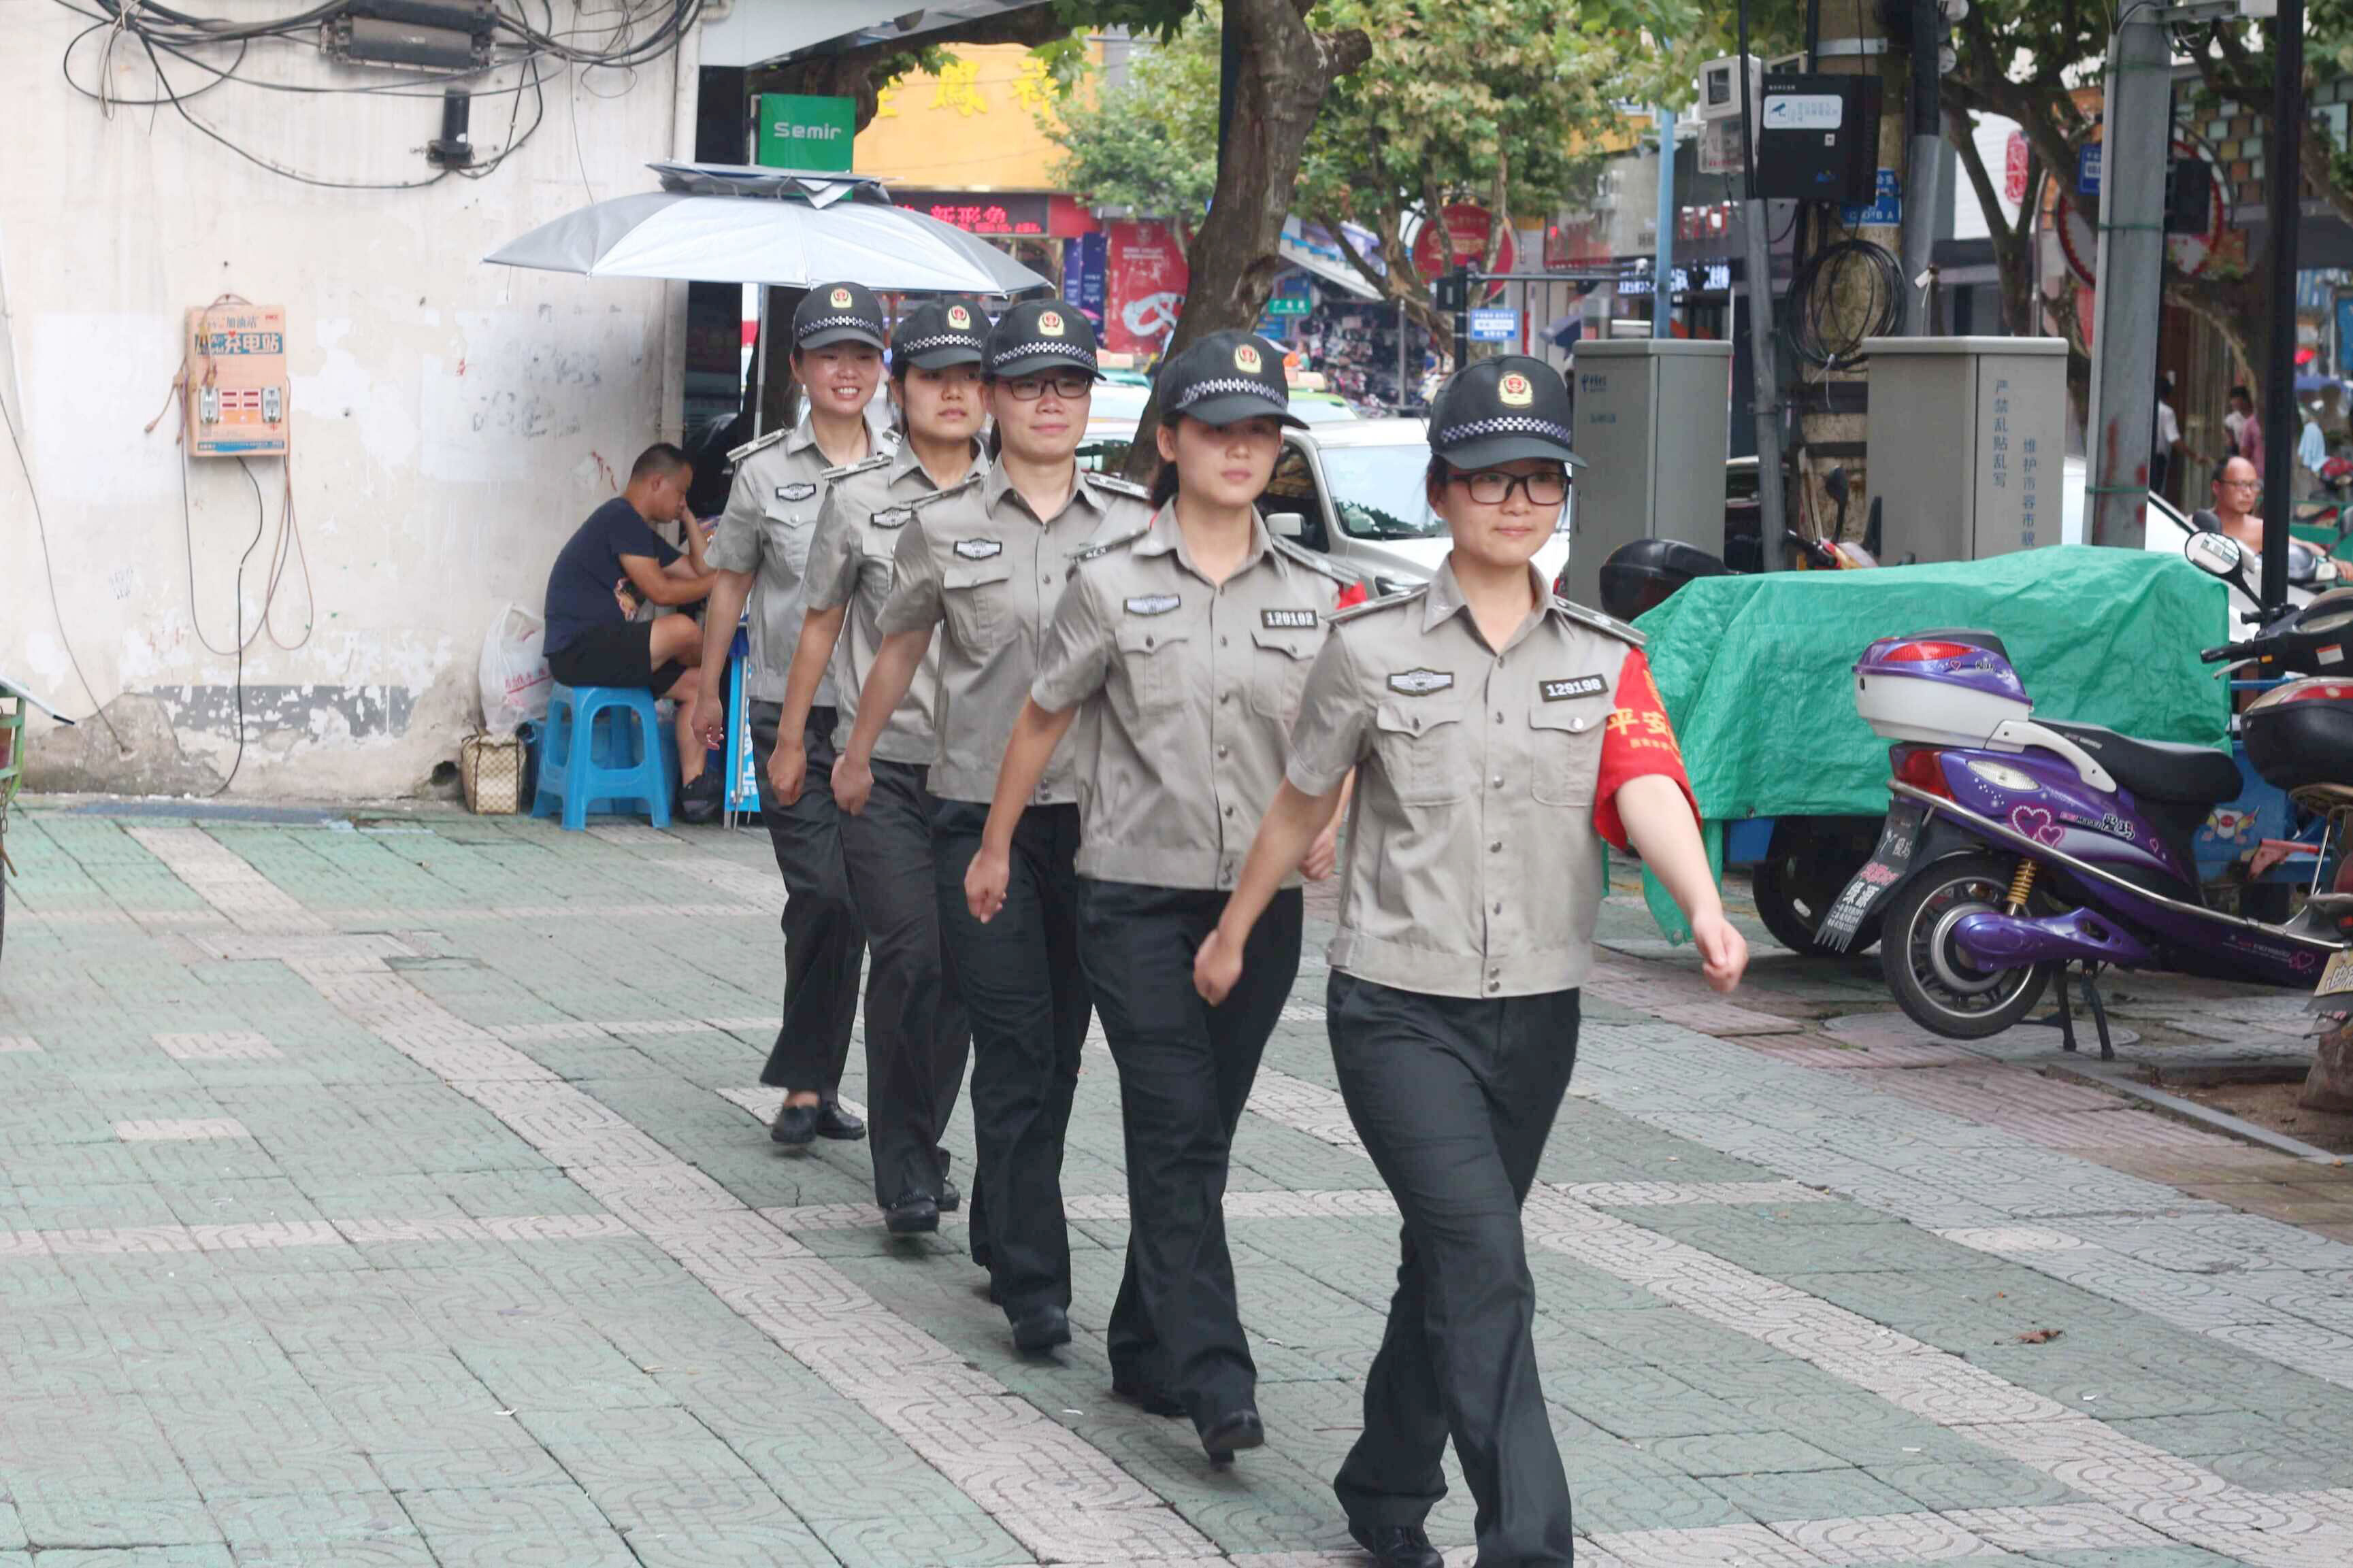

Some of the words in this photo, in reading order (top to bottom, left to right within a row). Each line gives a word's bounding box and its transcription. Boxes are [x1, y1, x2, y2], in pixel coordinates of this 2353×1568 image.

[774, 121, 842, 140] Semir
[1992, 380, 2009, 488] 严禁乱贴乱写
[2022, 438, 2037, 547] 维护市容市貌
[1546, 678, 1602, 697] 129198
